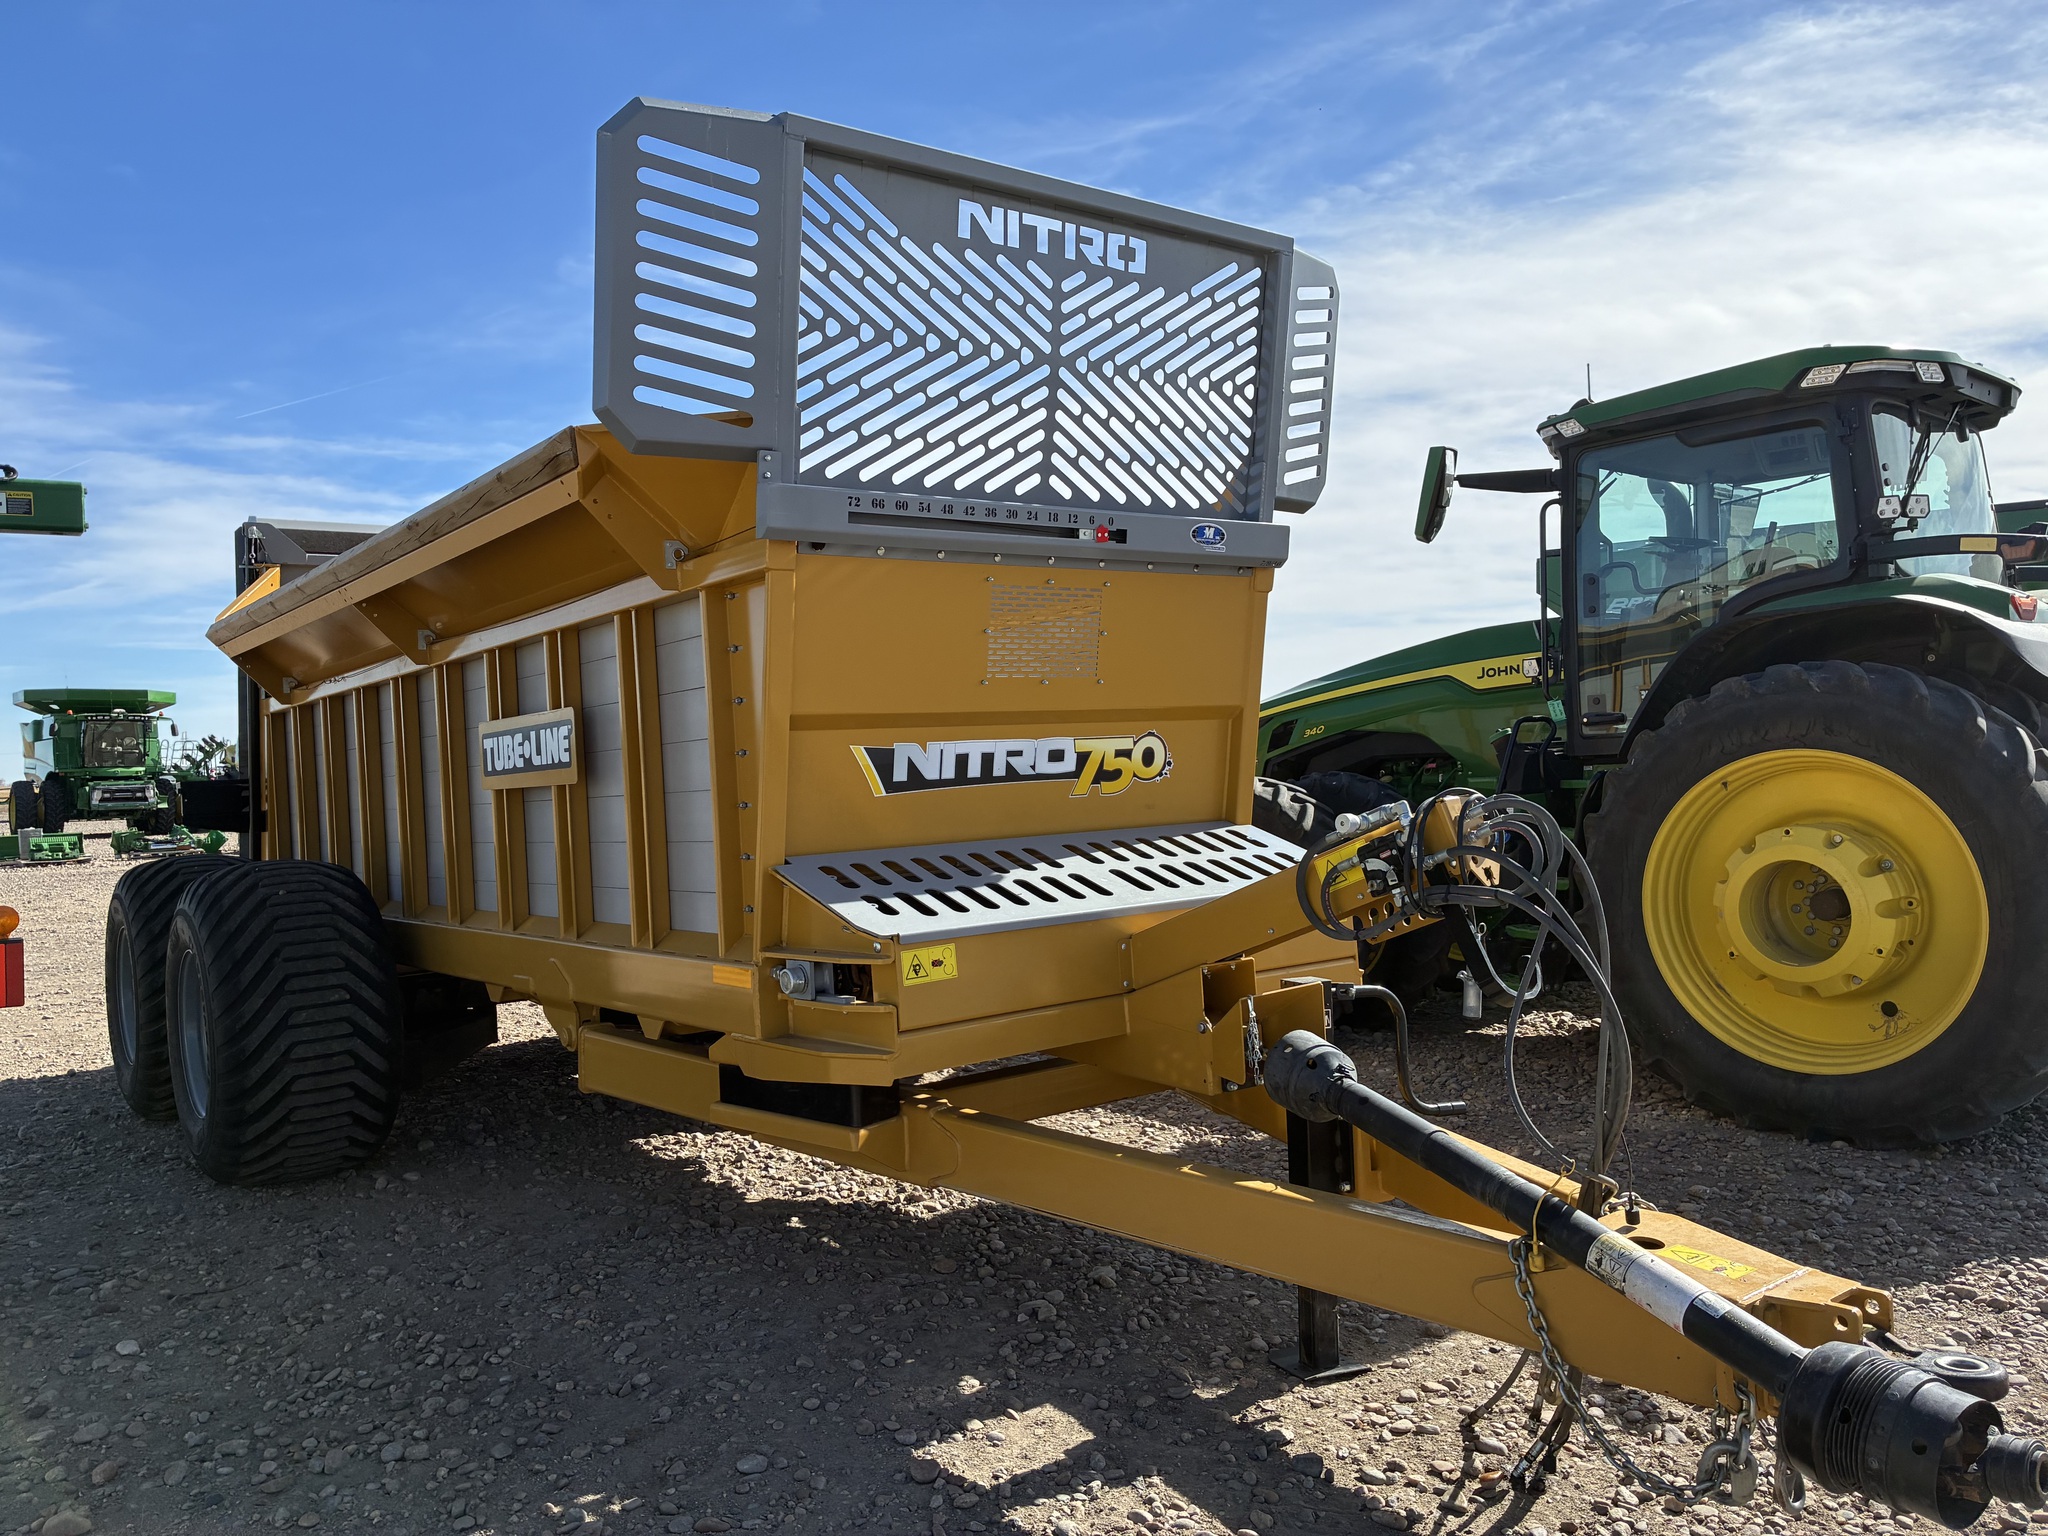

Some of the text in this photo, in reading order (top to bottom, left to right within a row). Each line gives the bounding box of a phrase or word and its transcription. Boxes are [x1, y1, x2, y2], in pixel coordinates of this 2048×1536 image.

[957, 198, 1147, 275] NITRO
[847, 496, 1114, 526] 72 66 60 54 48 42 36 30 24 18 12 6 0
[1477, 664, 1521, 679] JOHN
[1303, 725, 1325, 738] 340
[892, 734, 1166, 796] NITRO 750
